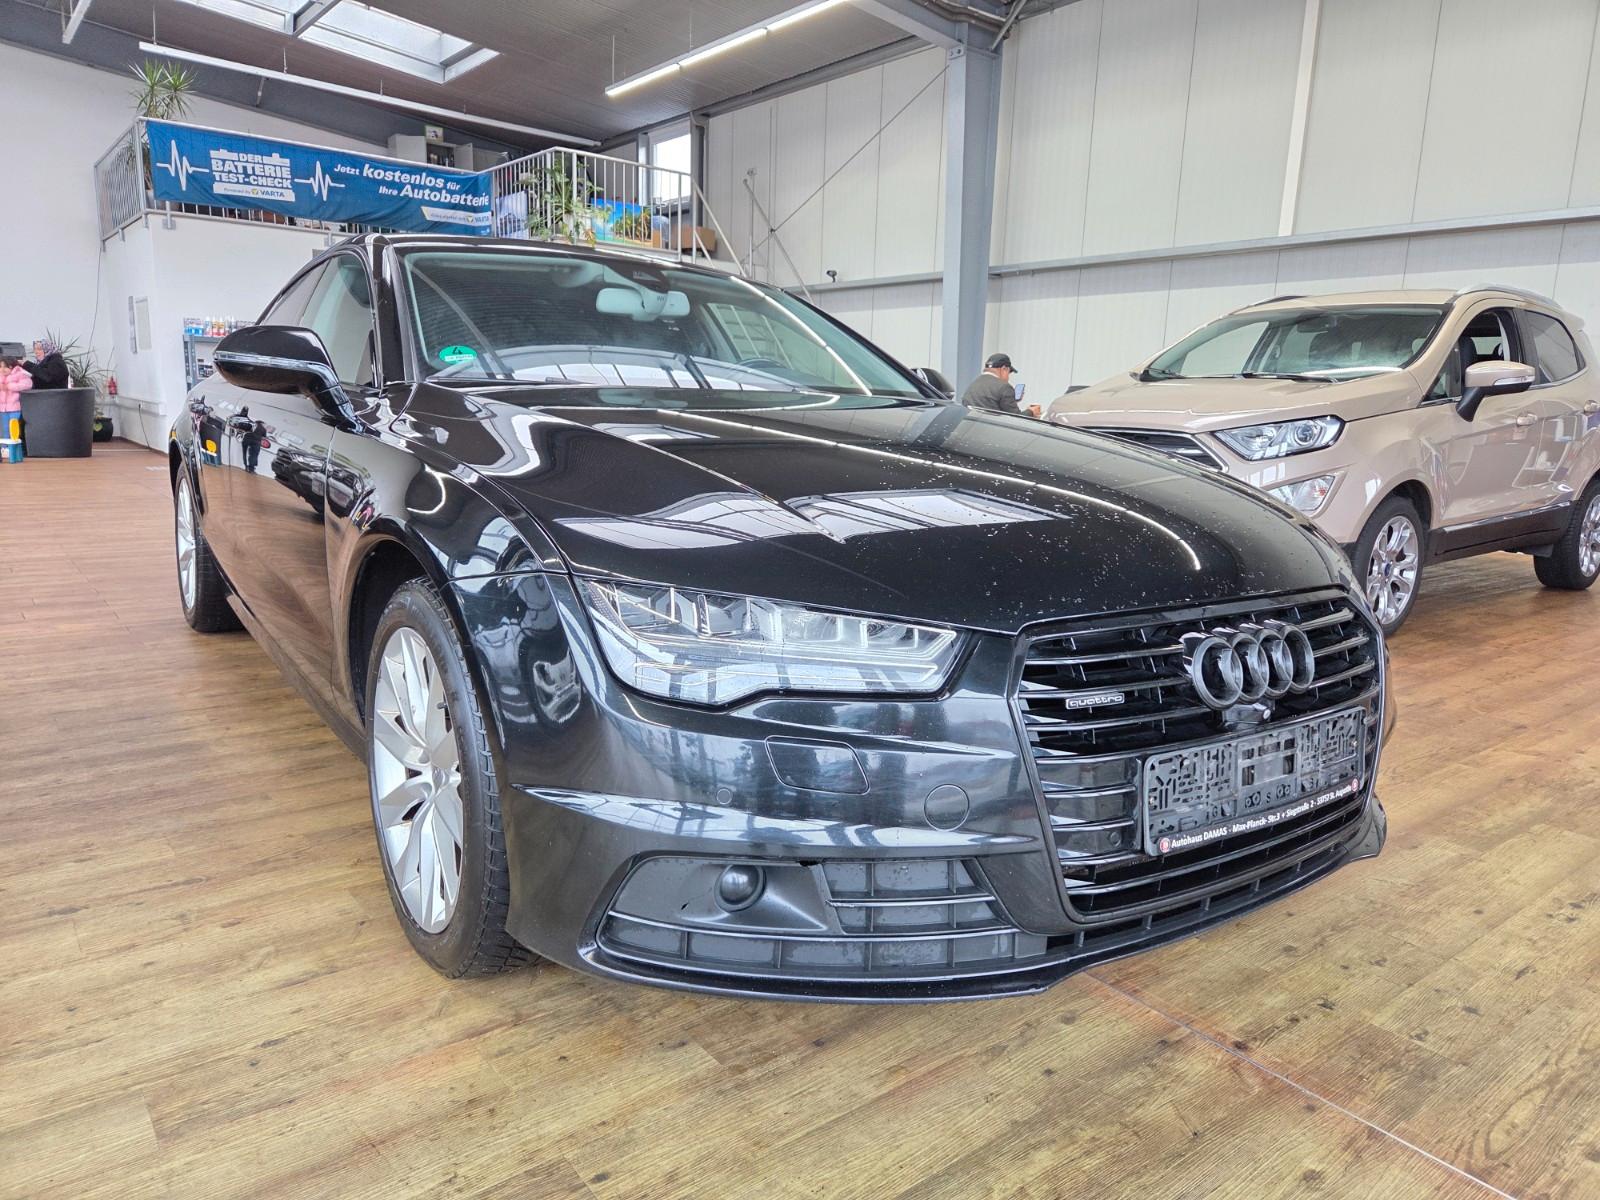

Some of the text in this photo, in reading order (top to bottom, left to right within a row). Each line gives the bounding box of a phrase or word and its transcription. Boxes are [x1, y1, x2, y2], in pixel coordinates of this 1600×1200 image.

[239, 153, 263, 163] DER
[211, 159, 291, 179] BATTERIE
[333, 164, 460, 190] Jetzt kostenlos für
[213, 172, 292, 188] TEST-CHECK
[260, 190, 285, 198] VARTA
[378, 184, 489, 206] Ihre Autobatterie
[1069, 695, 1122, 708] quattro
[1171, 834, 1202, 848] Autohaus
[1203, 826, 1228, 840] DAMAS
